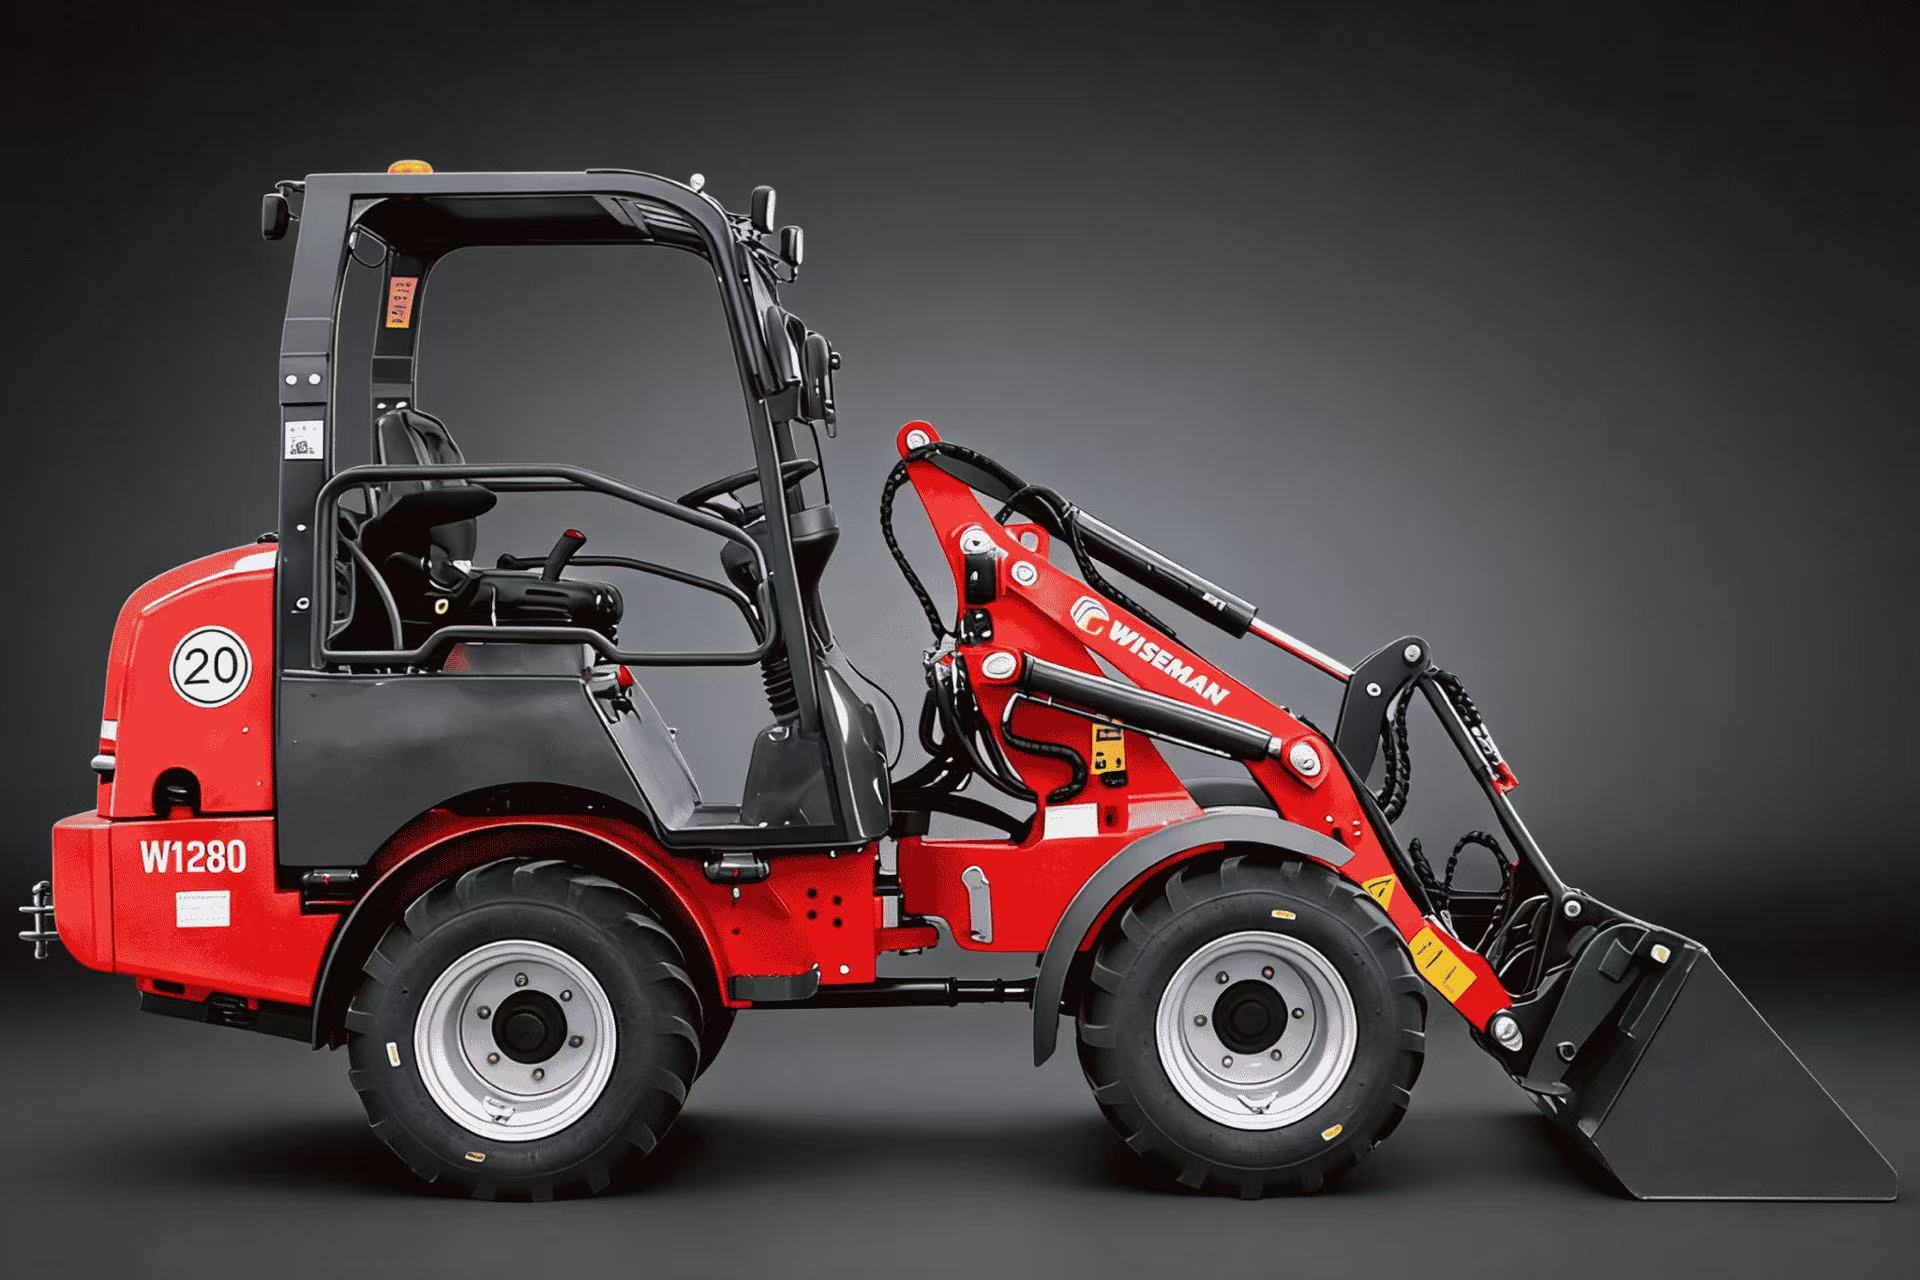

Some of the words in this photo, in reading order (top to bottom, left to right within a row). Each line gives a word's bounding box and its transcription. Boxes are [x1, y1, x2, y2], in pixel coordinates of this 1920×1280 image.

[184, 646, 238, 685] 20
[1109, 619, 1230, 706] WISEMAN
[140, 839, 246, 873] W1280
